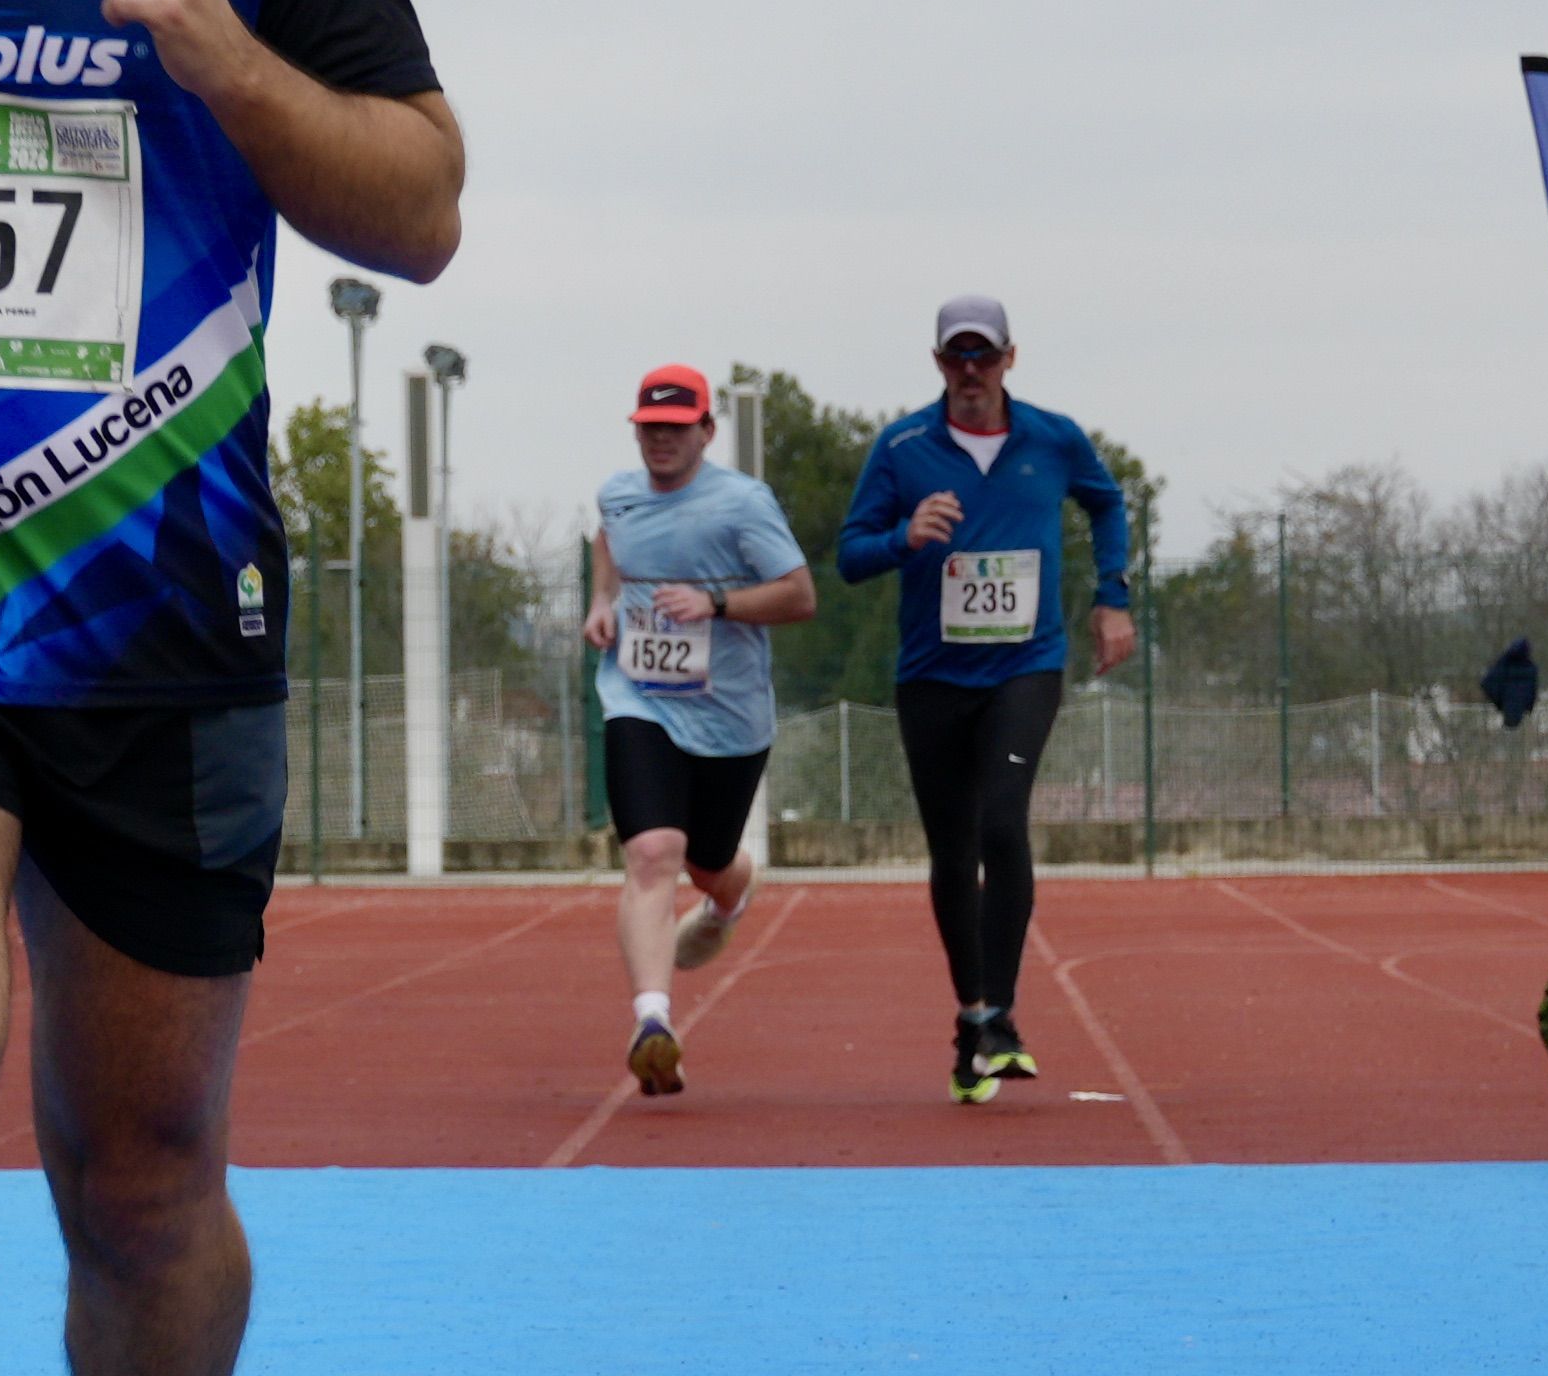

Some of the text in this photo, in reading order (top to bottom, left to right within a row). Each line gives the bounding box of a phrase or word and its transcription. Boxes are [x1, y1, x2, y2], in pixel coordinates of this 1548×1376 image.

[44, 362, 195, 487] Lucena
[962, 582, 1017, 614] 235
[632, 639, 691, 674] 1522
